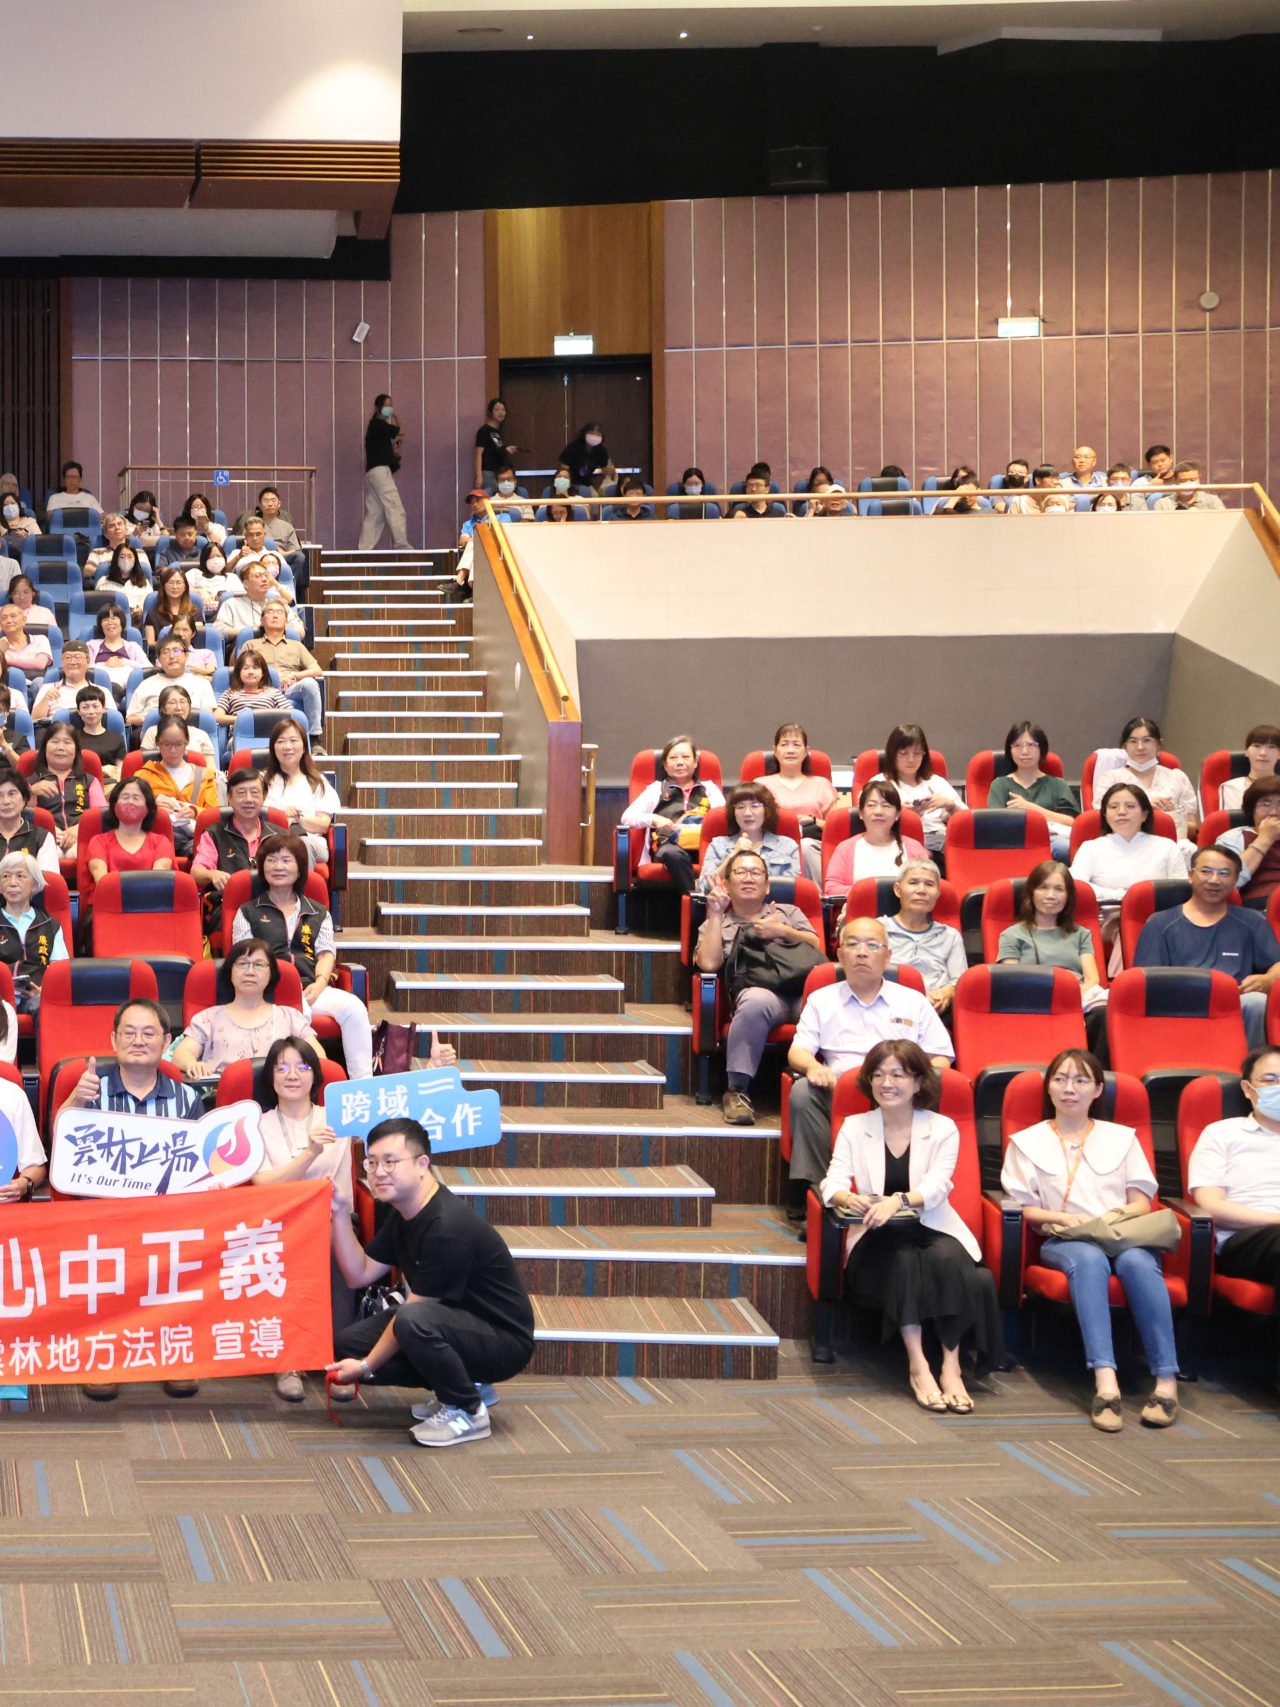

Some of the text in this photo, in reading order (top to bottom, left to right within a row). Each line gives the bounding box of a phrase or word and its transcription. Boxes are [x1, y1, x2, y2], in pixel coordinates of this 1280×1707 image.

[340, 1084, 410, 1127] 跨域
[419, 1103, 483, 1141] 合作
[64, 1123, 200, 1195] 雲林上場
[70, 1172, 152, 1191] It's Our Time
[211, 1316, 284, 1362] 宣導
[448, 1416, 471, 1436] N
